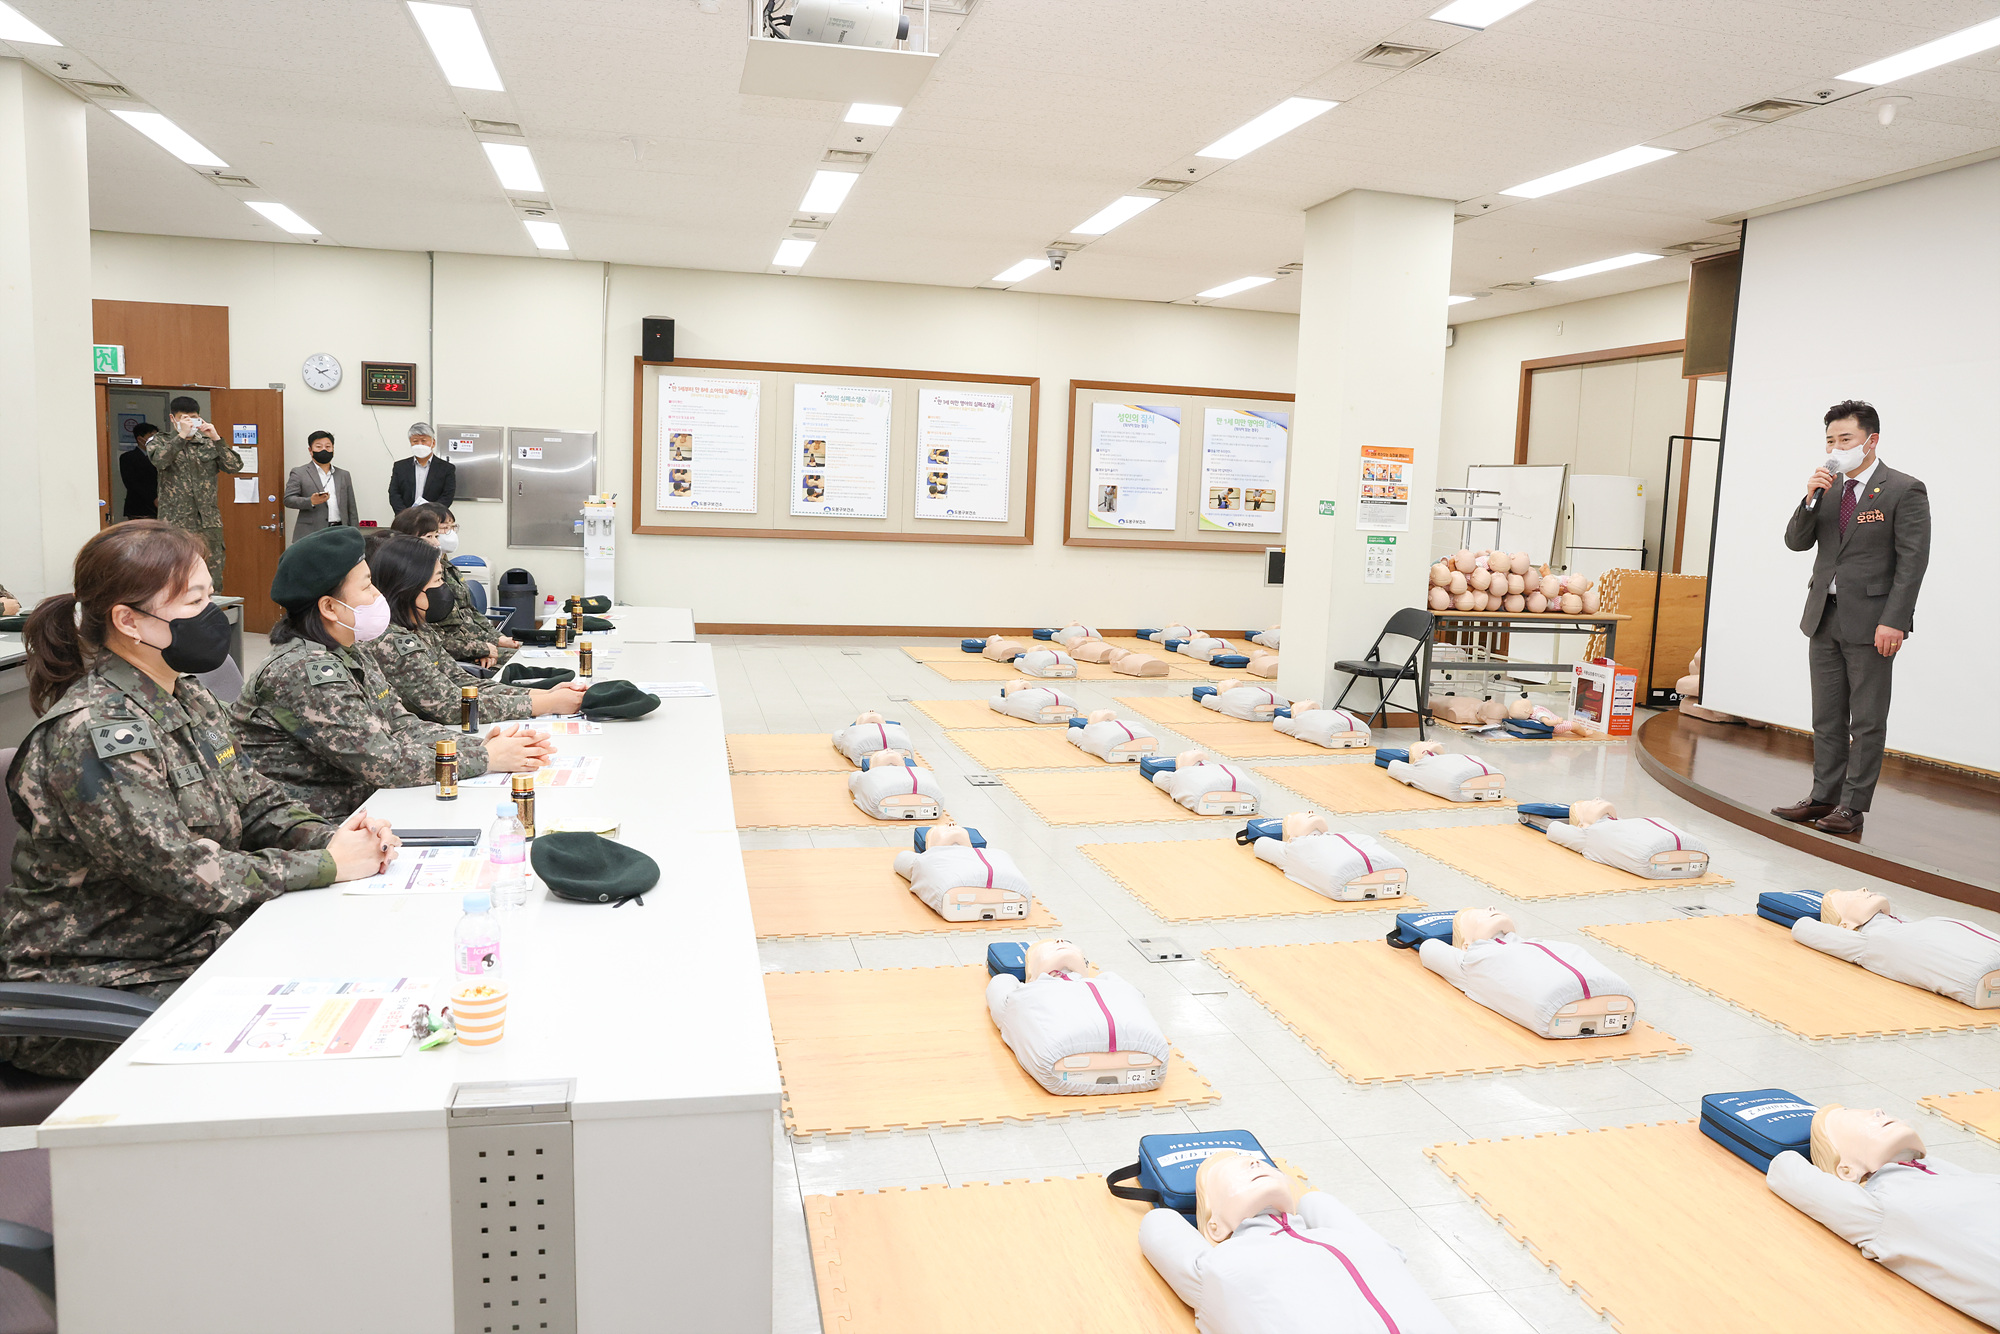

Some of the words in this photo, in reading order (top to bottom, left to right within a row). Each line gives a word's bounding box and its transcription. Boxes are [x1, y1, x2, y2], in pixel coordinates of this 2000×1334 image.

[824, 394, 840, 402] 성인의
[840, 395, 866, 403] 심폐소생술
[1117, 413, 1139, 423] 성인의
[1140, 414, 1155, 424] 질식
[1234, 418, 1246, 426] 미만
[1247, 419, 1264, 427] 영아의
[1857, 512, 1885, 524] 오언석
[1169, 1140, 1243, 1150] HEARTSTART
